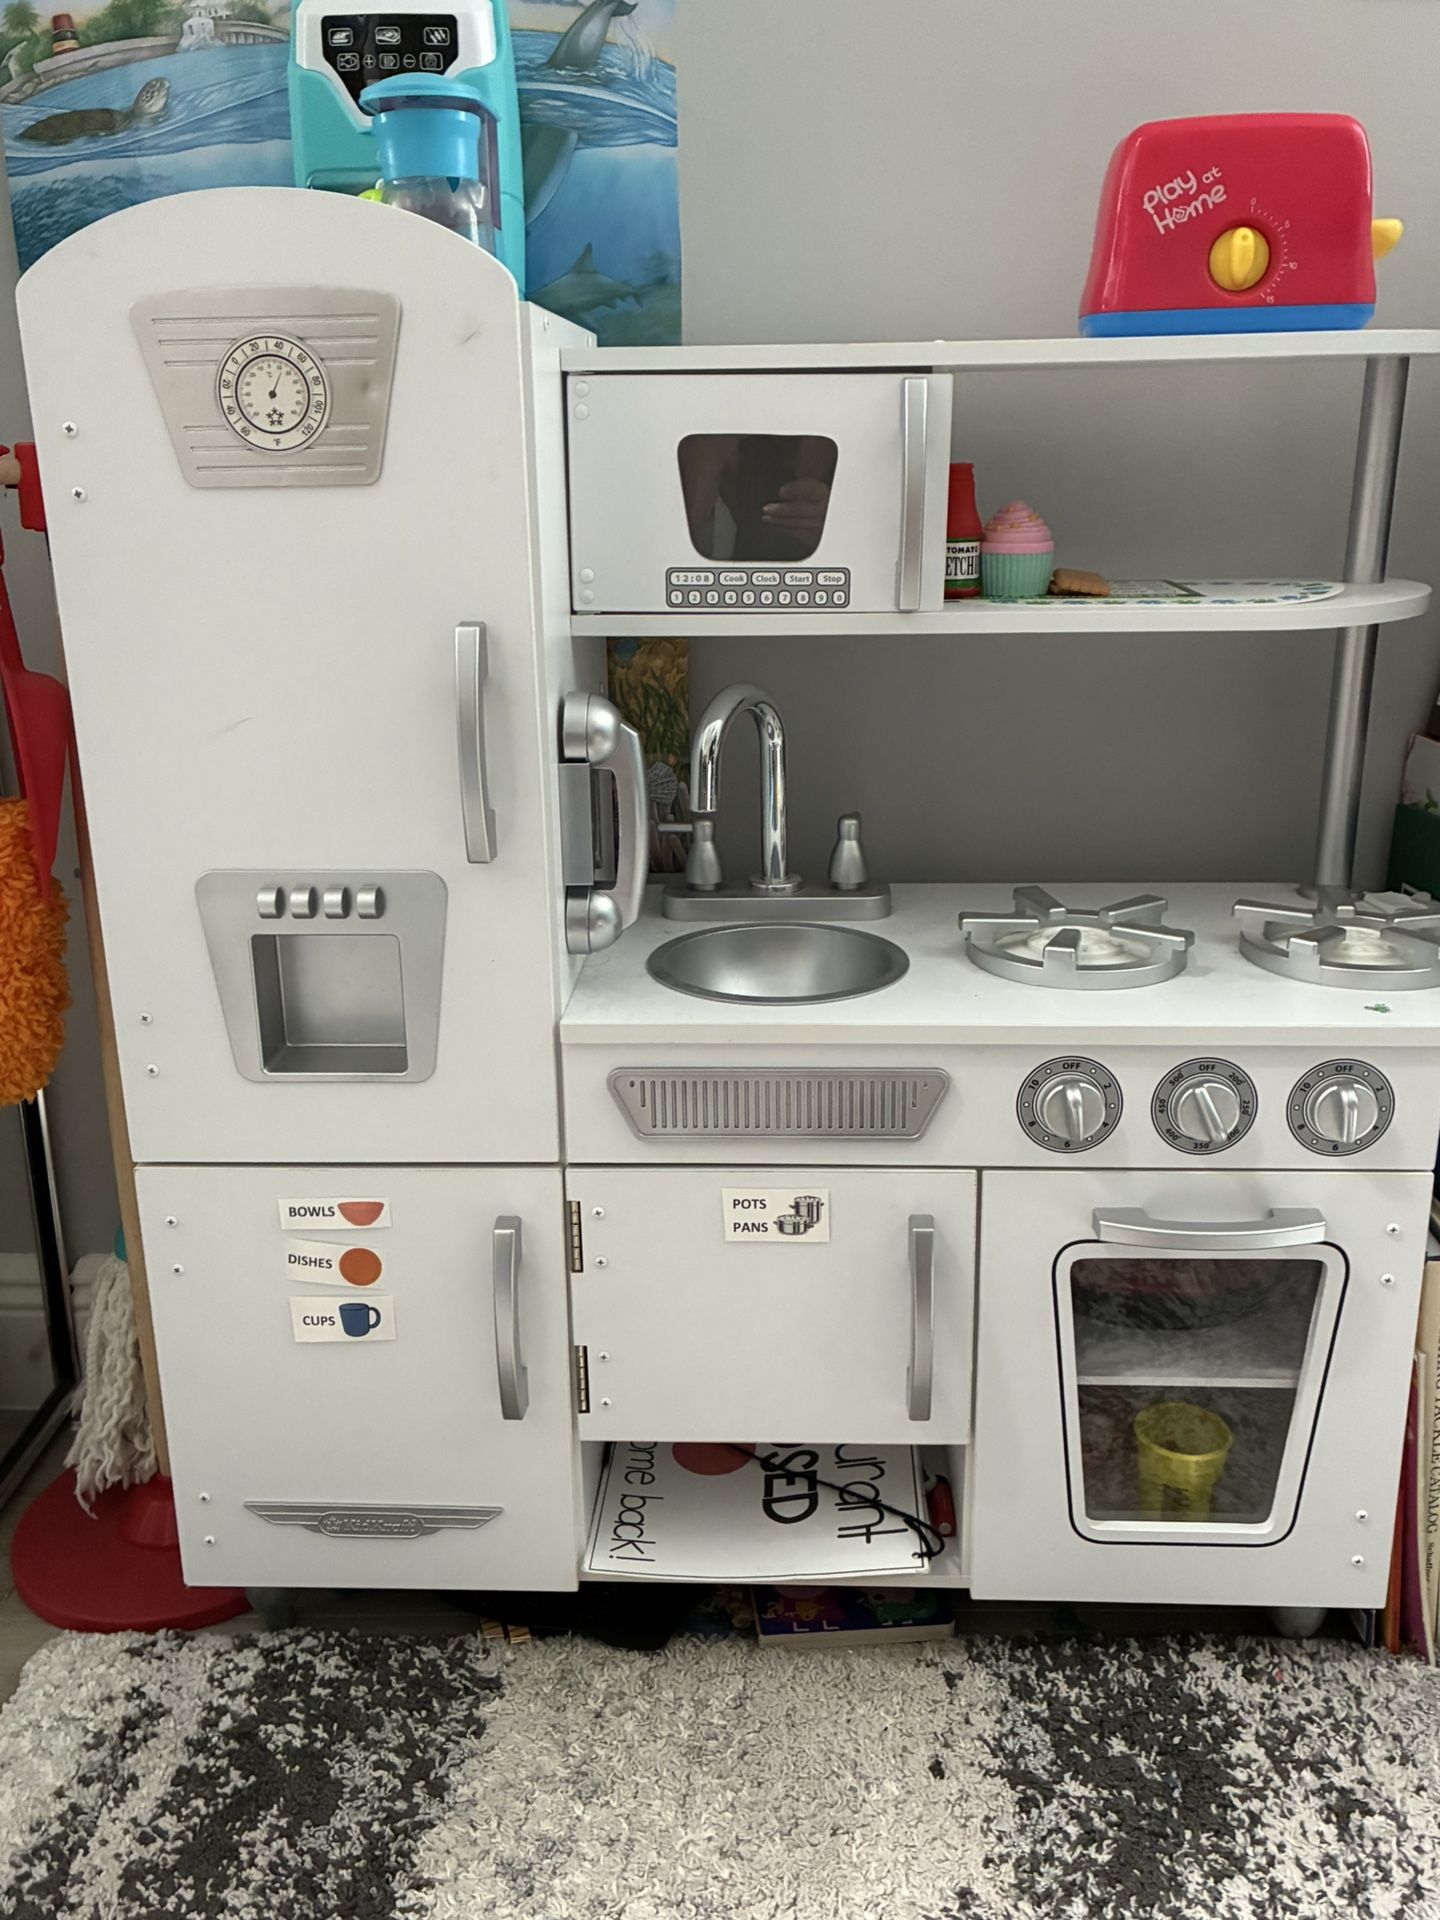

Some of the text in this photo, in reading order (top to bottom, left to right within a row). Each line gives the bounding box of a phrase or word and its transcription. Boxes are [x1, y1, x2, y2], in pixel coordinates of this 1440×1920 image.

[1143, 166, 1222, 215] Play at
[1151, 184, 1227, 235] Home
[1289, 262, 1298, 270] 10
[1266, 296, 1274, 304] 15
[249, 341, 260, 352] 20
[273, 341, 284, 350] 40
[232, 357, 239, 365] 0
[296, 352, 307, 364] 60
[222, 379, 231, 390] 20
[312, 375, 321, 386] 80
[226, 404, 236, 416] 40
[314, 400, 324, 414] 100
[301, 423, 314, 436] 120
[675, 574, 842, 584] 12:08 Cook Clock Start Stop
[674, 594, 679, 602] 1
[692, 594, 697, 602] 2
[710, 594, 716, 602] 3
[728, 594, 734, 602] 4
[746, 594, 752, 602] 5
[782, 594, 788, 602] 7
[818, 594, 824, 602] 9
[1062, 1062, 1081, 1071] OFF
[1199, 1063, 1216, 1072] OFF
[1335, 1065, 1354, 1073] OFF
[1028, 1079, 1040, 1090] 10
[1104, 1082, 1112, 1090] 2
[1300, 1082, 1311, 1093] 10
[1064, 1140, 1070, 1148] 6
[732, 1198, 767, 1210] POTS
[288, 1206, 336, 1218] BOWLS
[733, 1222, 769, 1233] PANS
[288, 1254, 333, 1269] DISHES
[302, 1315, 336, 1326] CUPS
[761, 1443, 820, 1524] SED
[1426, 1465, 1440, 1534] CATALOG
[608, 1493, 664, 1562] back!
